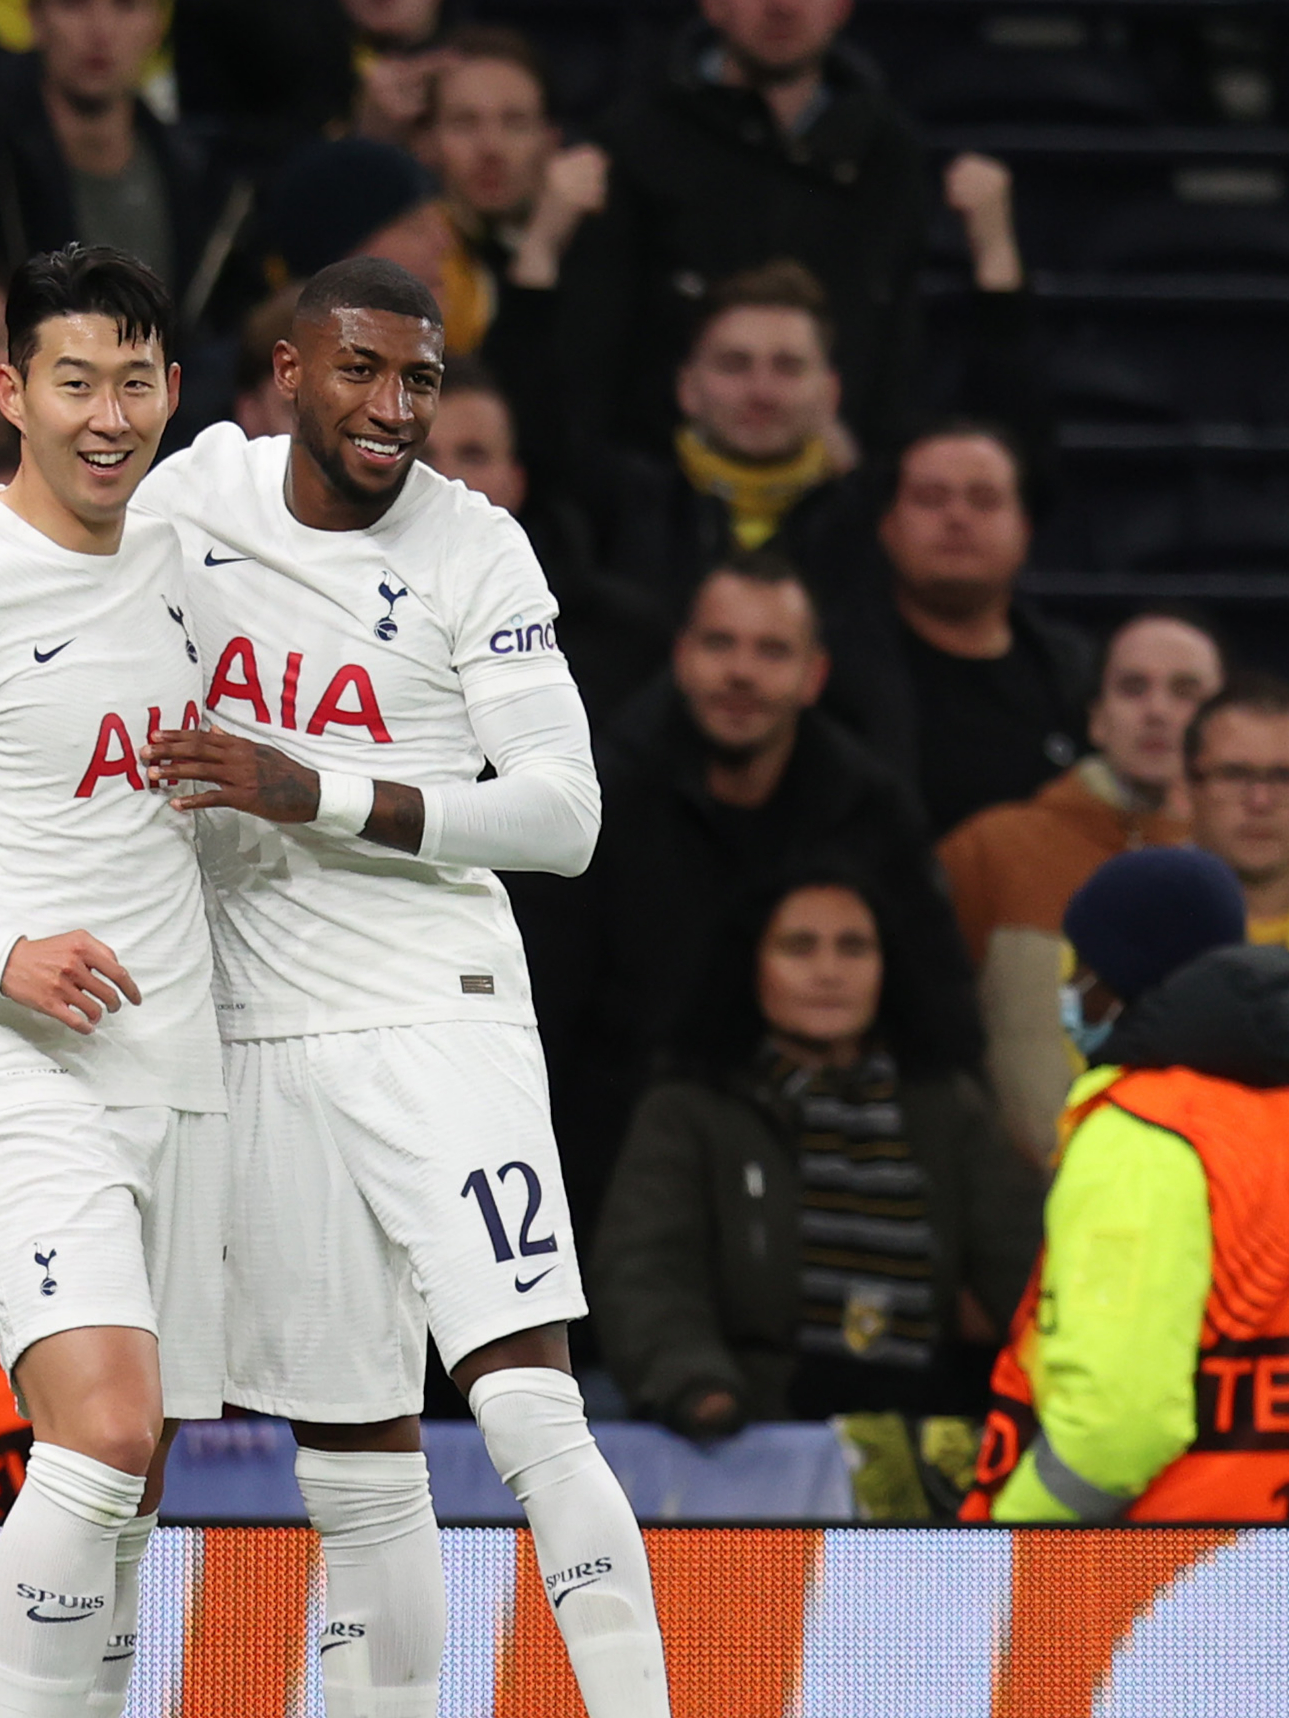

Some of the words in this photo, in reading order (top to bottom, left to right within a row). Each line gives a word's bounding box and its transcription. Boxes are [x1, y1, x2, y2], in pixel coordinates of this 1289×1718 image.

[205, 635, 394, 744] AIA
[460, 1160, 559, 1264] 12
[16, 1582, 105, 1610] SPURS
[545, 1556, 613, 1591] SPURS
